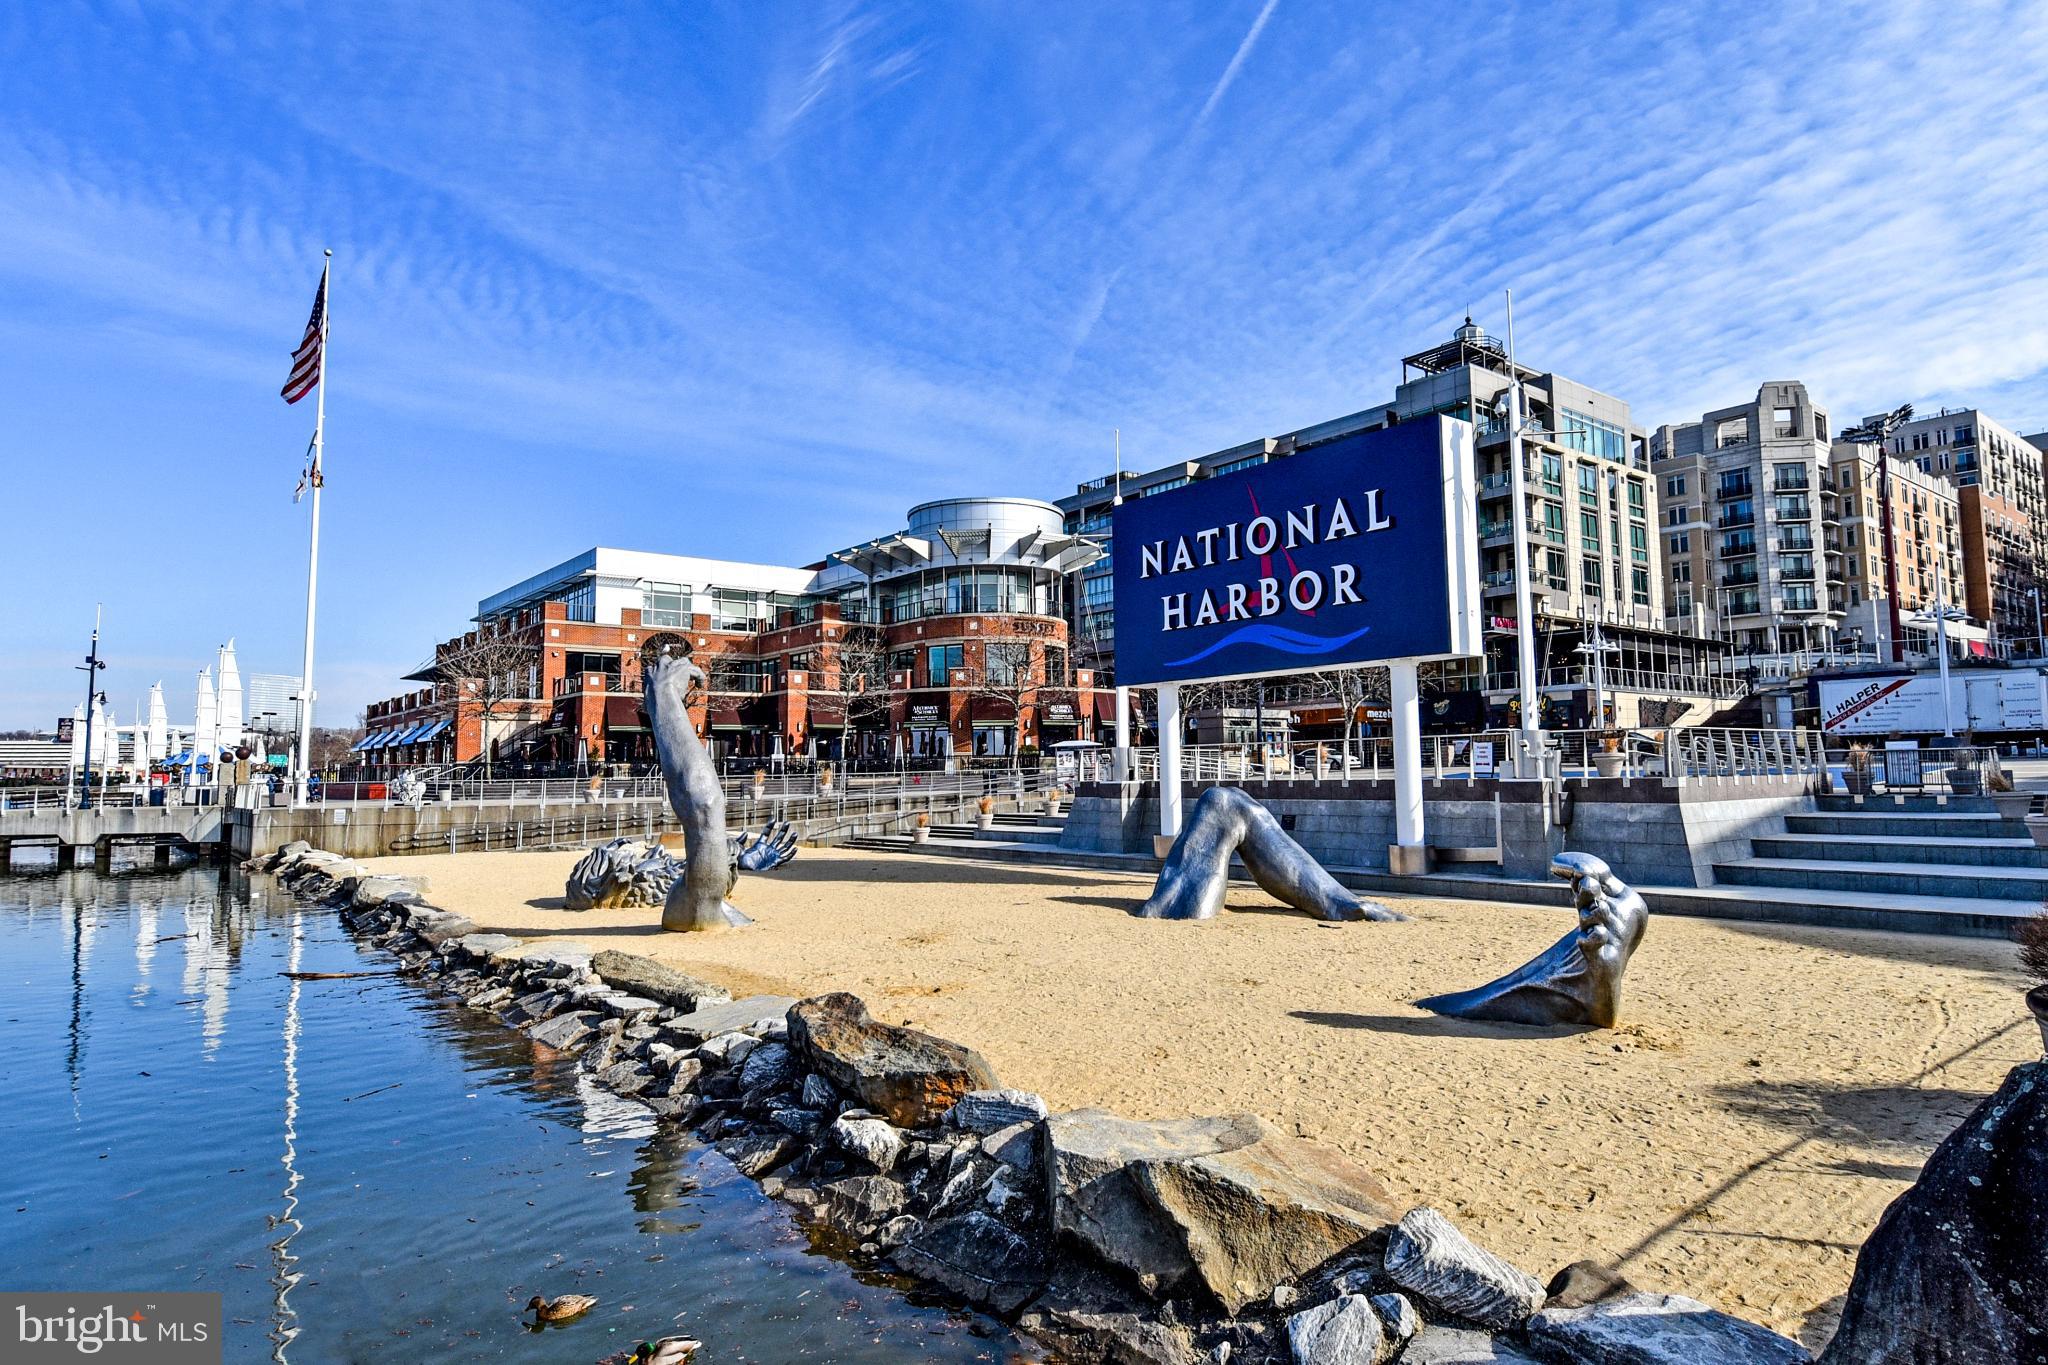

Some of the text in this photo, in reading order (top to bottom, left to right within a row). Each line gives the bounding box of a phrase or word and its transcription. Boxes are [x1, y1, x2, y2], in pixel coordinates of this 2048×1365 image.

[1140, 489, 1391, 579] NATIONAL
[1161, 563, 1363, 632] HARBOR
[1366, 709, 1392, 719] mezeh
[1827, 682, 1880, 718] I. HALPER
